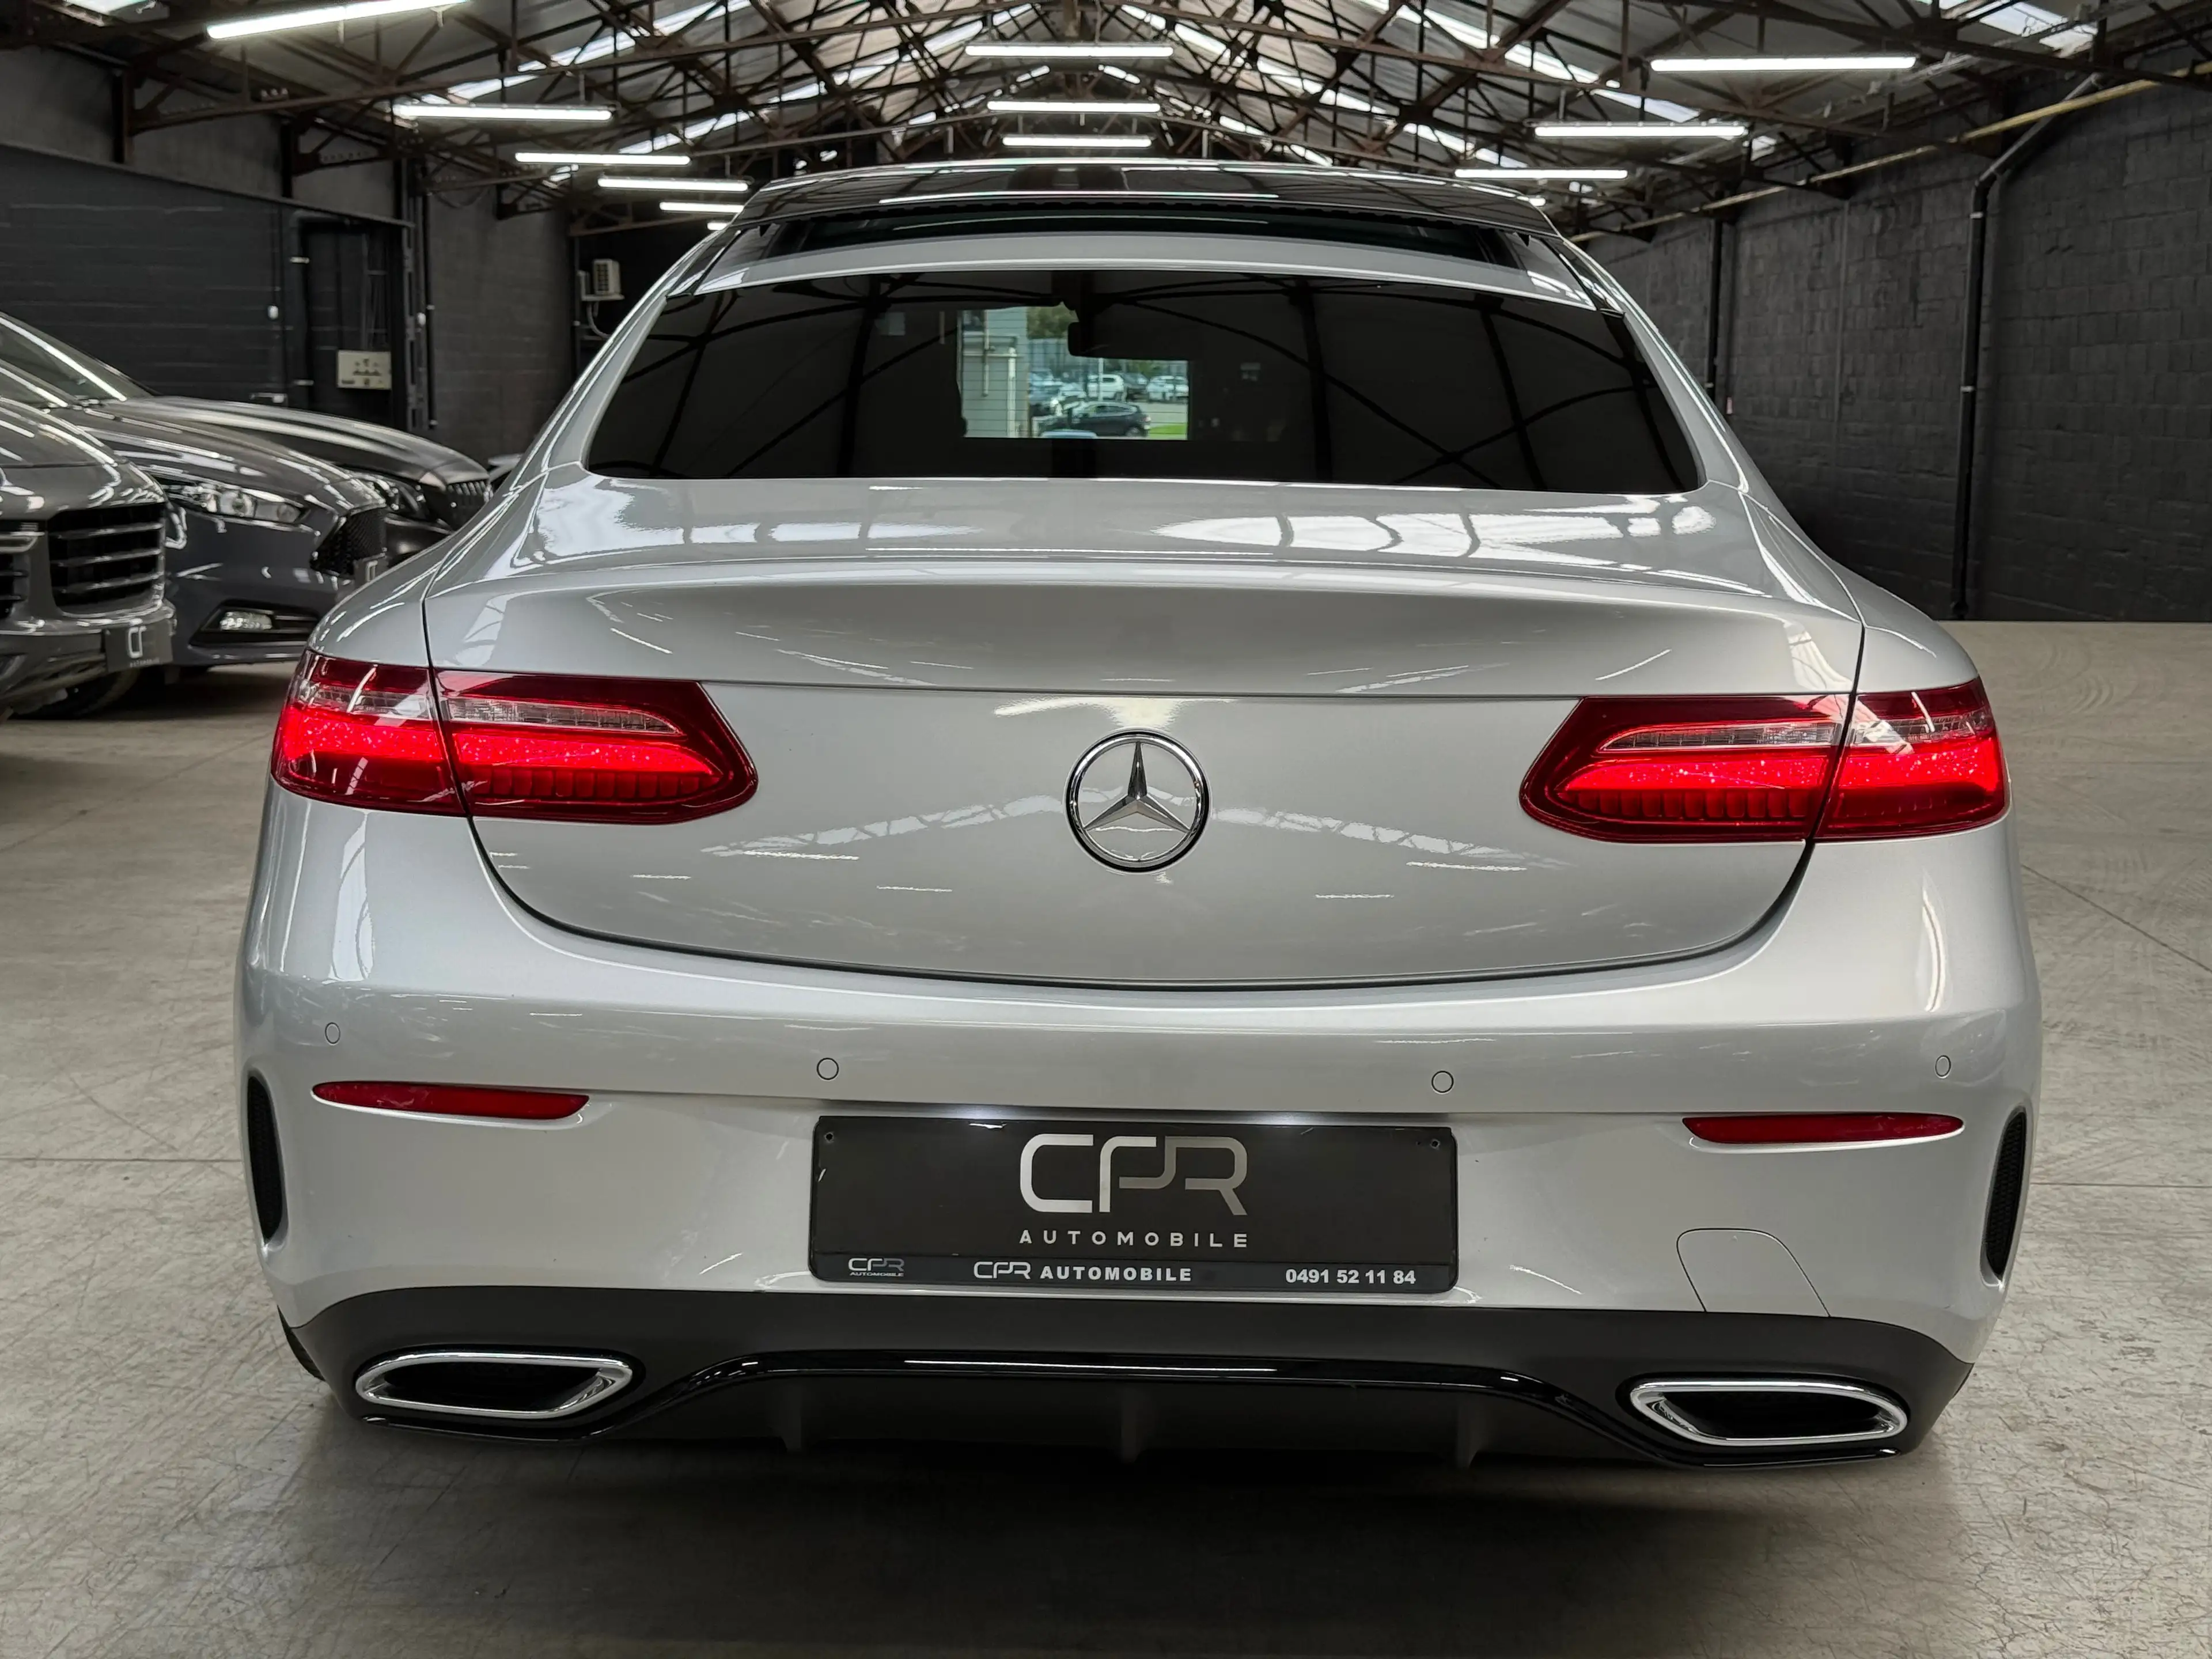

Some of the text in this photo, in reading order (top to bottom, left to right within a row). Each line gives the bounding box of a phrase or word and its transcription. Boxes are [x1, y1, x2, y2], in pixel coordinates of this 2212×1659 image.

[1020, 1133, 1247, 1215] CPR
[1019, 1229, 1247, 1248] AUTOMOBILE
[848, 1257, 905, 1272] CPR
[974, 1261, 1192, 1282] CPR AUTOMOBILE
[1285, 1268, 1416, 1285] 0491 52 11 84
